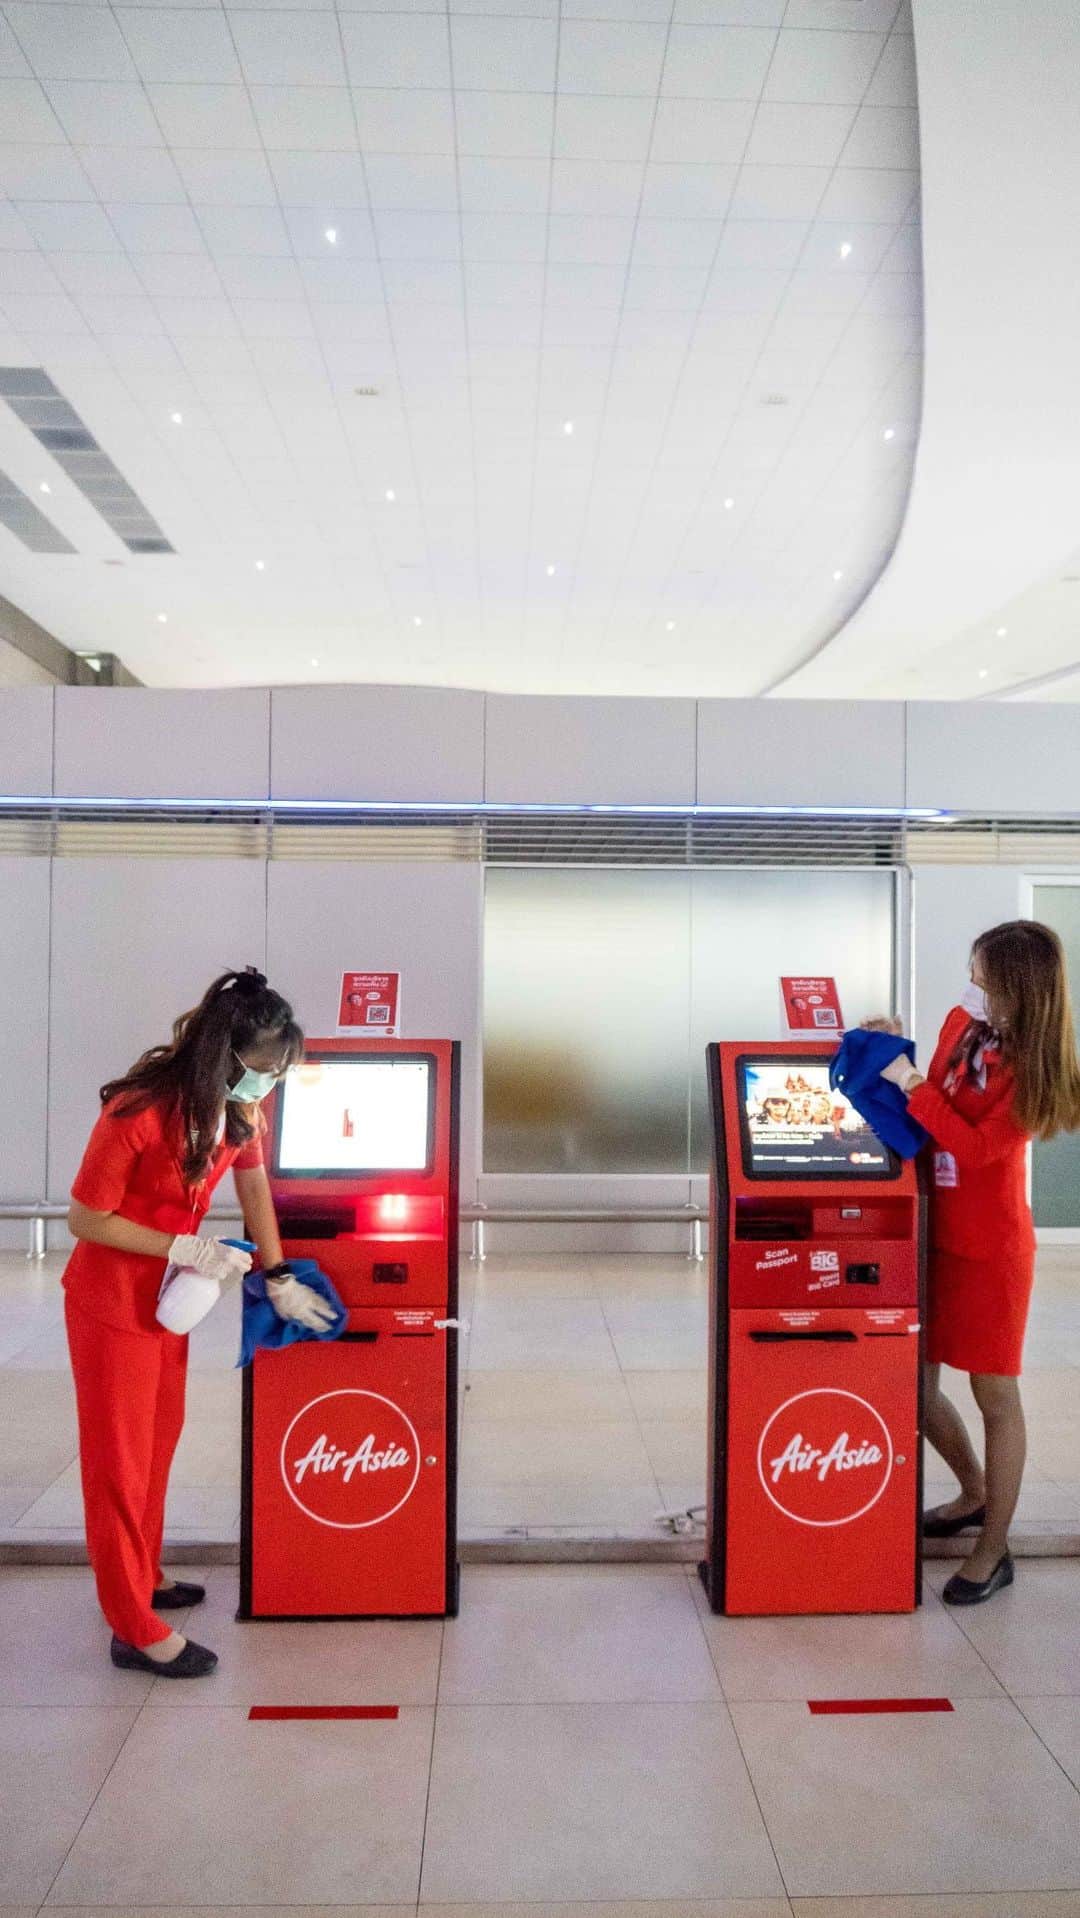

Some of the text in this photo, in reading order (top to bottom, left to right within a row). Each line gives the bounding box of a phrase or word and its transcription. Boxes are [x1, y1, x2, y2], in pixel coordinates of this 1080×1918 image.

[765, 1248, 788, 1259] Scan
[811, 1254, 839, 1268] BIG
[756, 1254, 797, 1271] Passport
[294, 1433, 410, 1484] AirAsia
[770, 1432, 882, 1483] AirAsia
